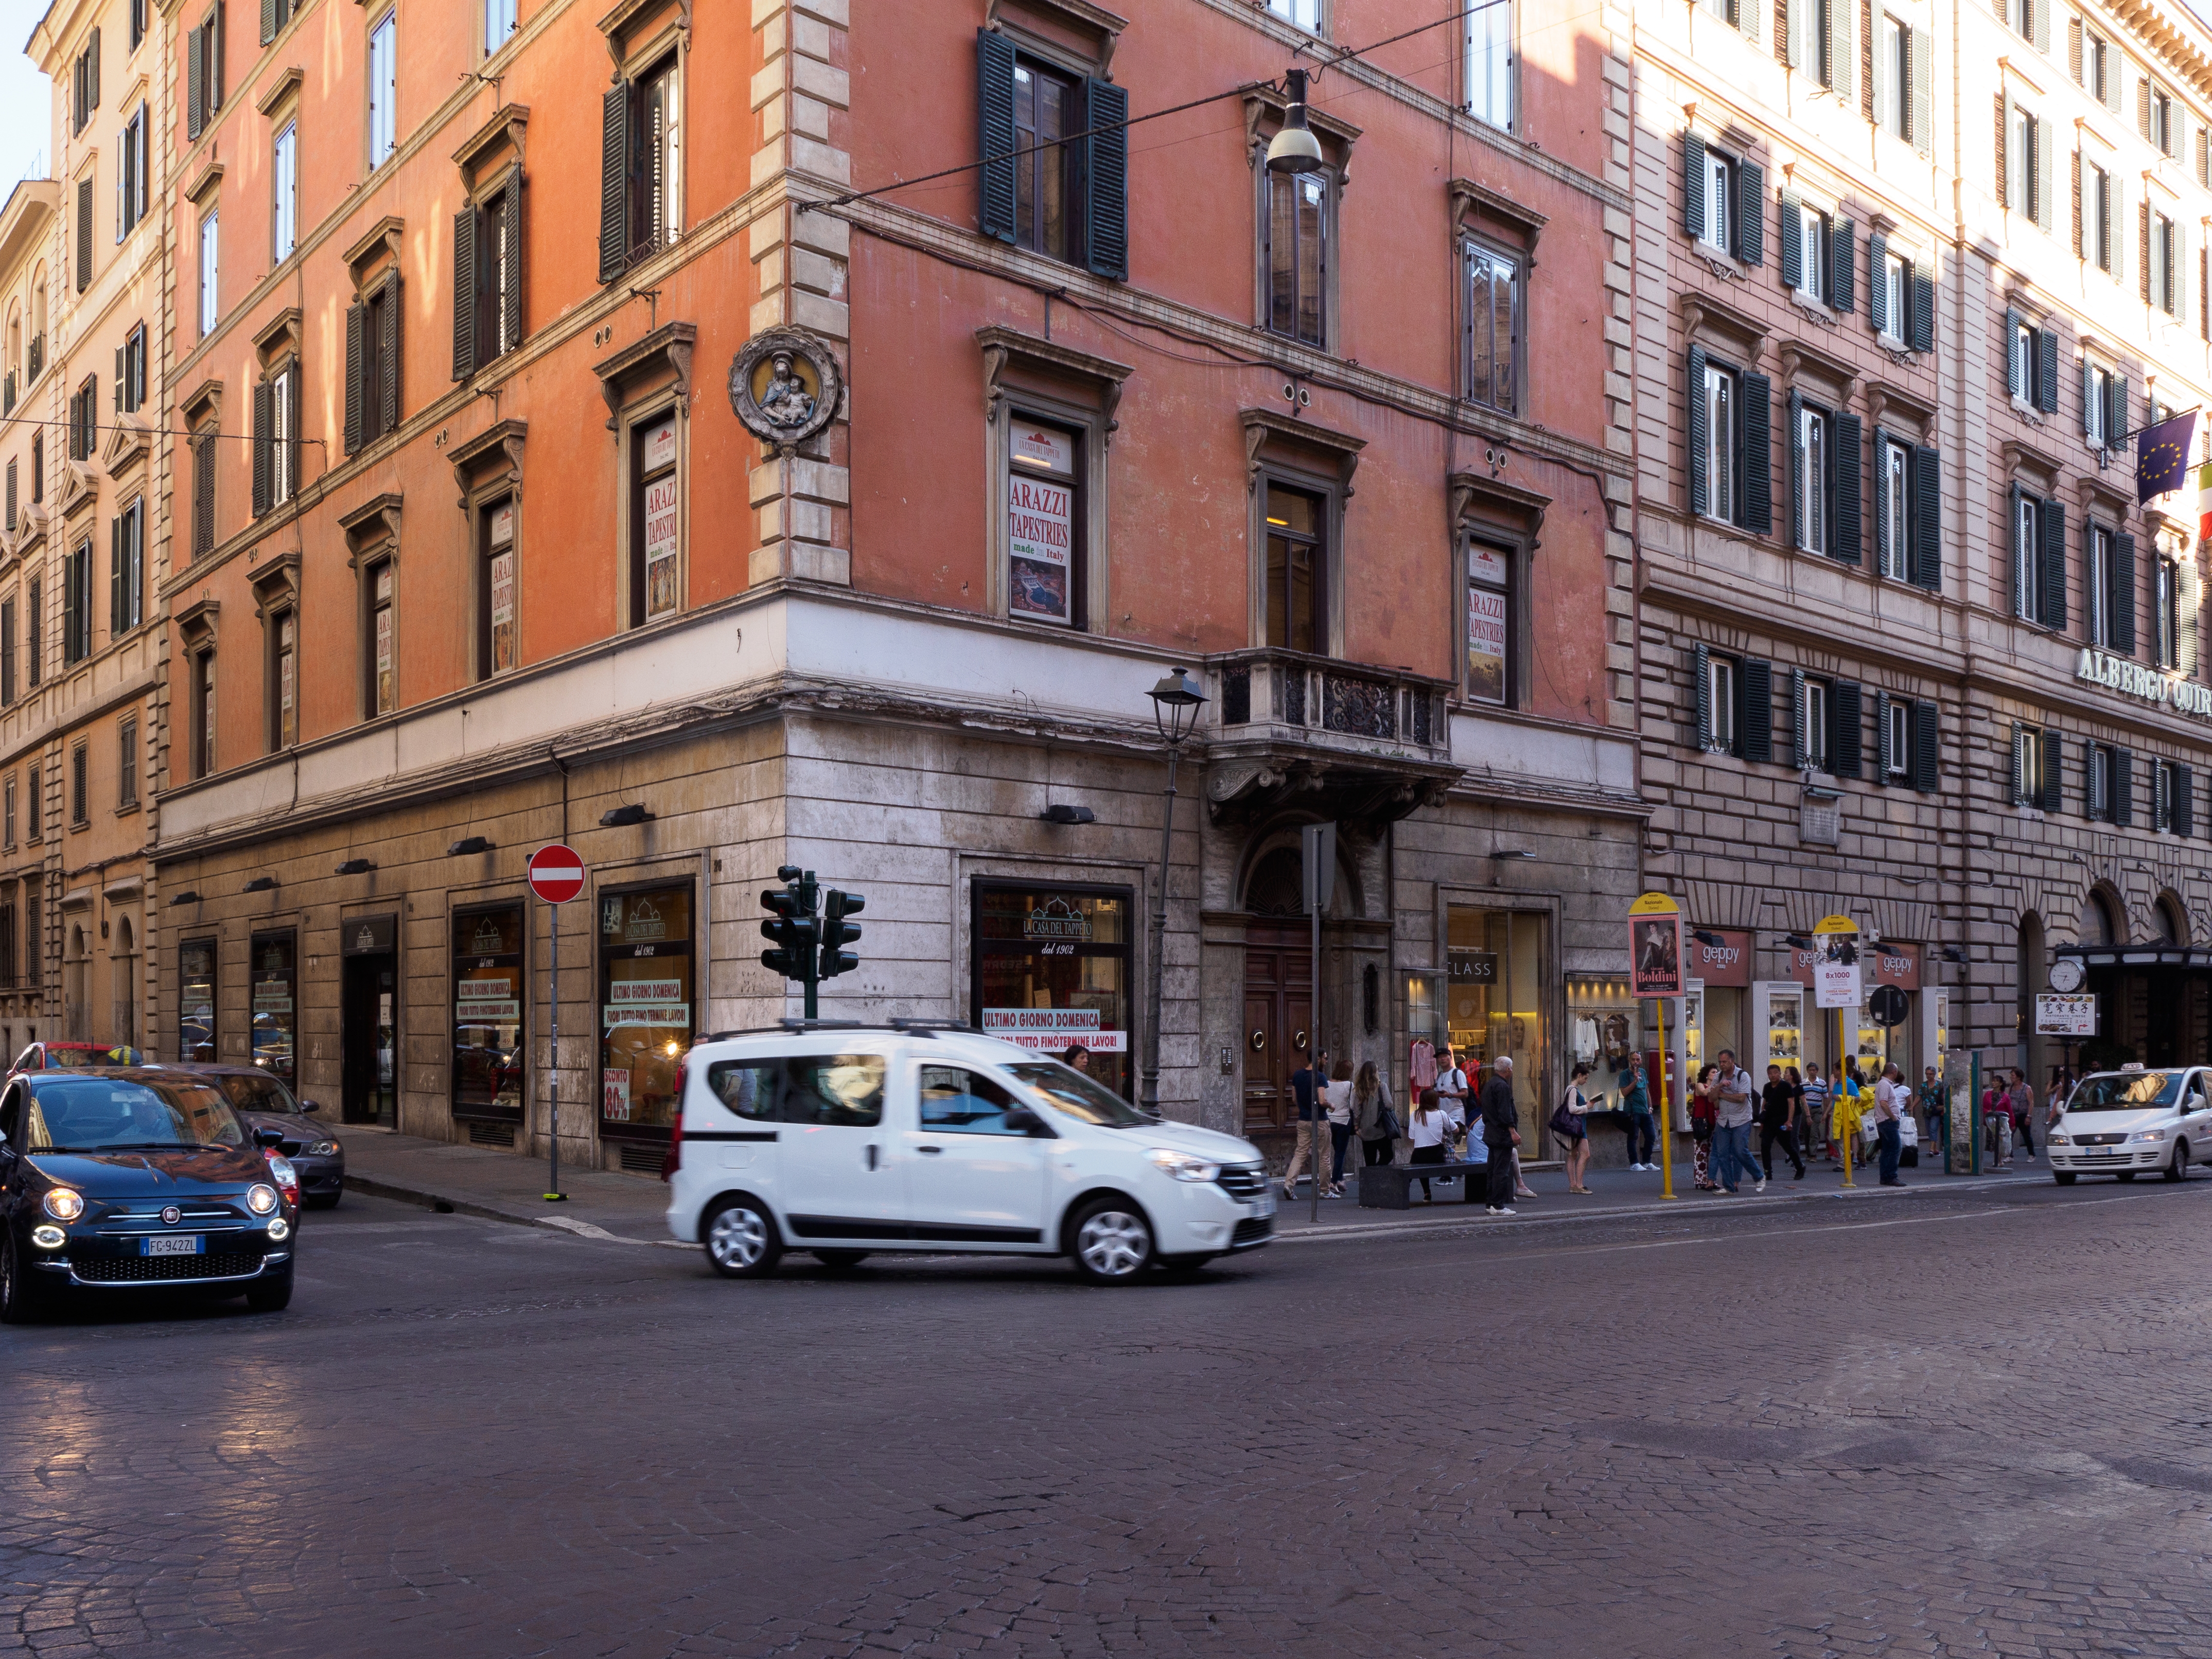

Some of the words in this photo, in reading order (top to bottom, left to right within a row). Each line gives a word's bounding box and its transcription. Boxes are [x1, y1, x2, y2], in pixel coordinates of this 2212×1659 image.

[1019, 440, 1024, 449] LA
[1025, 442, 1035, 453] CASA
[1044, 447, 1060, 459] TAPPETO
[648, 480, 676, 516] ARAZ
[1010, 482, 1067, 517] ARAZZI
[1010, 513, 1067, 548] TAPESTRIES
[650, 545, 663, 558] made
[1013, 543, 1034, 555] made
[1037, 546, 1044, 557] in
[1046, 548, 1064, 562] Italy
[494, 556, 512, 584] ARAZ
[1489, 644, 1501, 656] Italy
[2077, 648, 2168, 702] ALBERGO
[2173, 679, 2212, 716] QUIR
[1024, 921, 1031, 933] LA
[1032, 921, 1049, 934] CASA
[1050, 922, 1063, 934] DEL
[1064, 923, 1092, 936] TAPPETO
[635, 945, 643, 956] dal
[643, 946, 654, 956] 1902
[1042, 943, 1055, 955] dal
[1056, 945, 1074, 955] 1902
[1703, 946, 1739, 964] geppy
[1884, 957, 1912, 973] geppy
[1638, 970, 1677, 983] Boldini
[461, 983, 474, 996] ULTIMO
[475, 983, 489, 996] GIORNO
[490, 982, 510, 995] DOMENICA
[613, 985, 630, 999] ULTIMO
[632, 984, 652, 999] GIORNO
[653, 983, 679, 998] DOMENICA
[607, 1010, 620, 1023] FUORI
[621, 1010, 635, 1022] TUTTO
[636, 1010, 647, 1022] FINO
[647, 1009, 668, 1022] TERMINE
[669, 1009, 686, 1021] LAVORI
[984, 1012, 1016, 1027] ULTIMO
[1019, 1012, 1054, 1027] GIORNO
[1056, 1013, 1099, 1027] DOMENICA
[1015, 1036, 1038, 1048] TUTTO
[1092, 1035, 1116, 1047] LAVORI
[605, 1069, 627, 1083] SCONTO
[606, 1086, 627, 1119] 80%
[167, 1211, 177, 1220] FIAT
